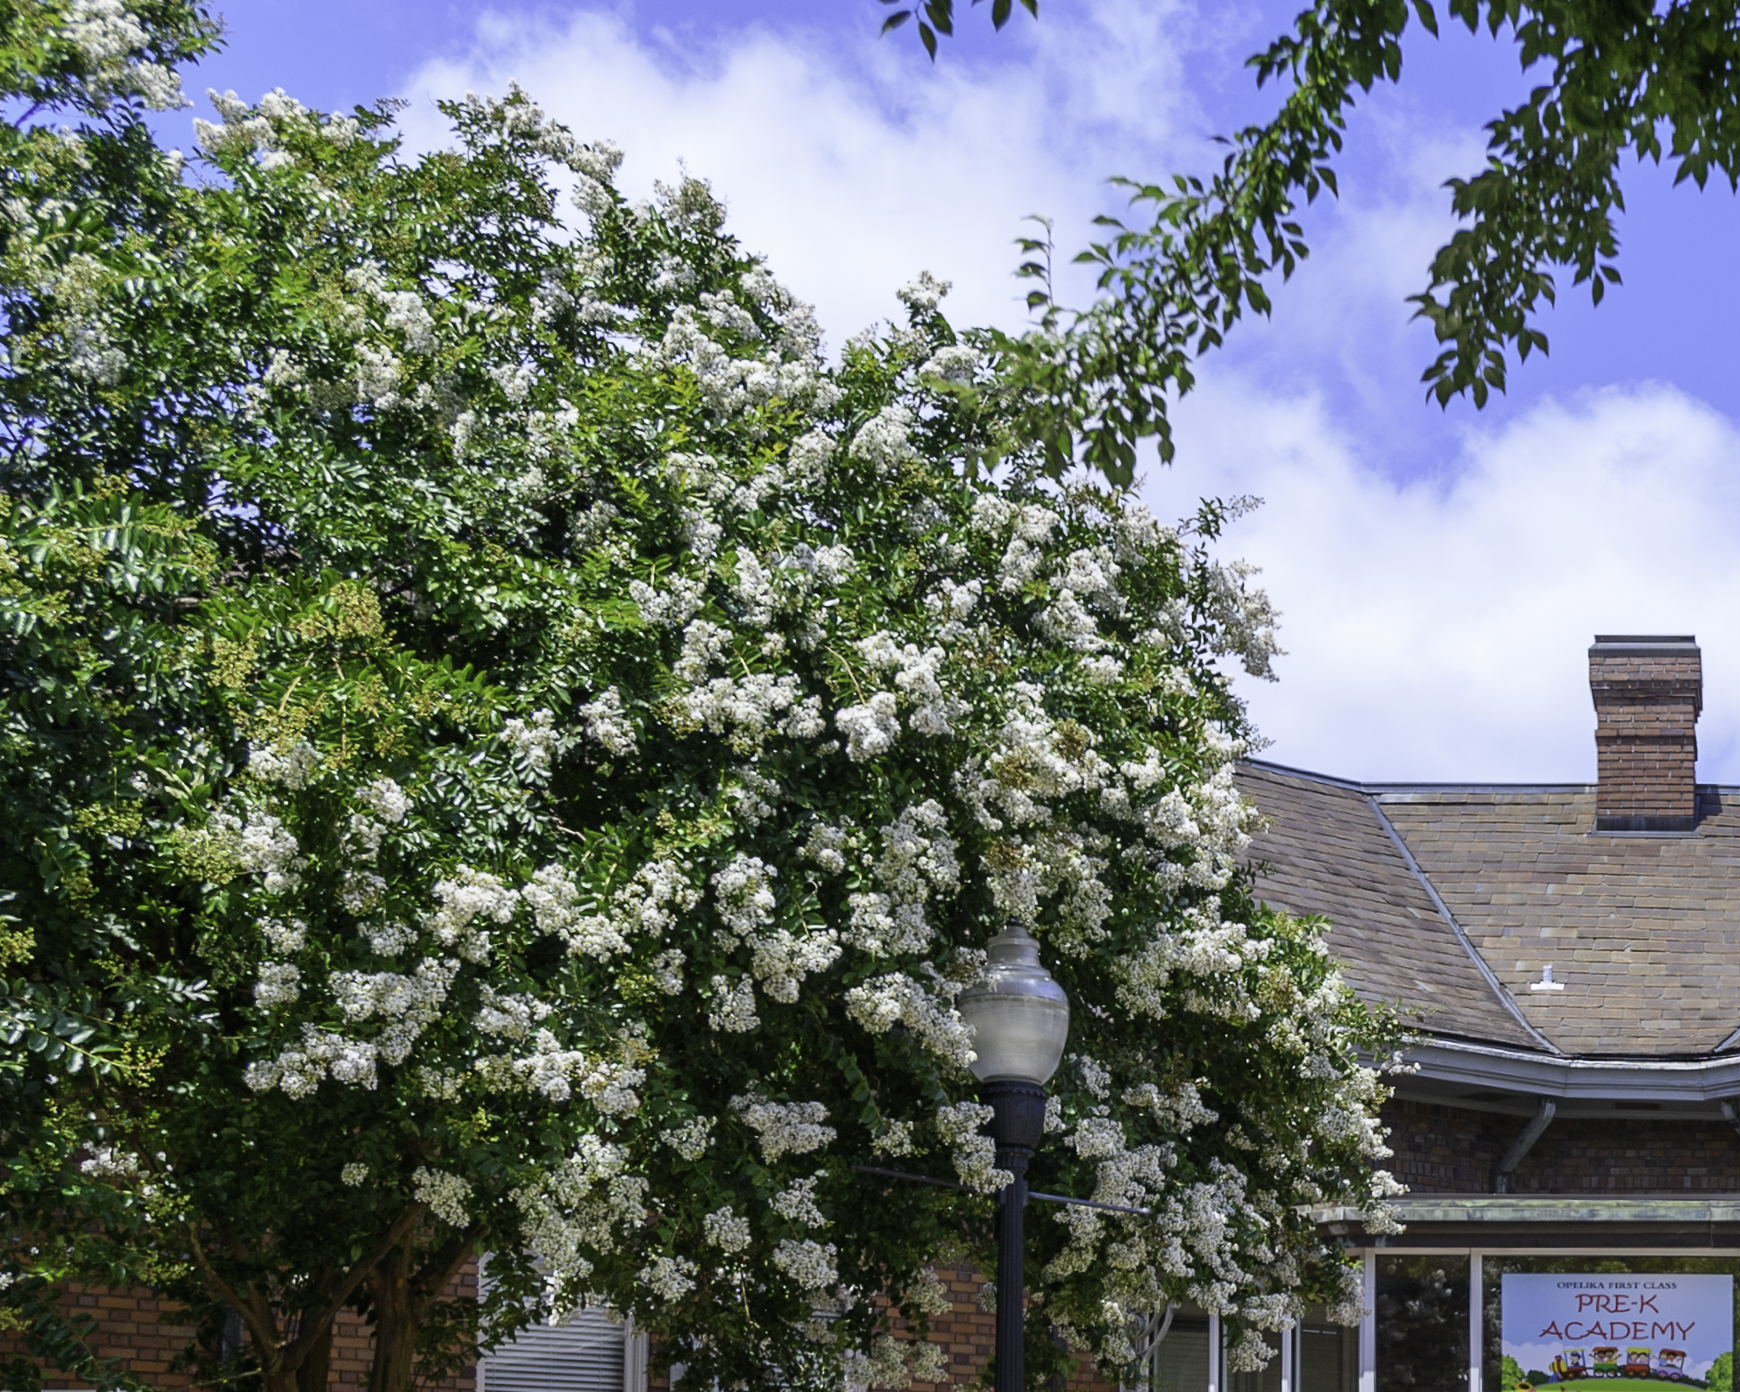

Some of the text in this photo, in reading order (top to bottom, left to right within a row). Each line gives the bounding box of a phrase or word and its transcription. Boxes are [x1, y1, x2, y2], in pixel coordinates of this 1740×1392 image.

[1556, 1281, 1677, 1290] OPELIKA FIRST CLASS
[1575, 1293, 1660, 1314] PRE-K
[1539, 1320, 1696, 1341] ACADEMY
